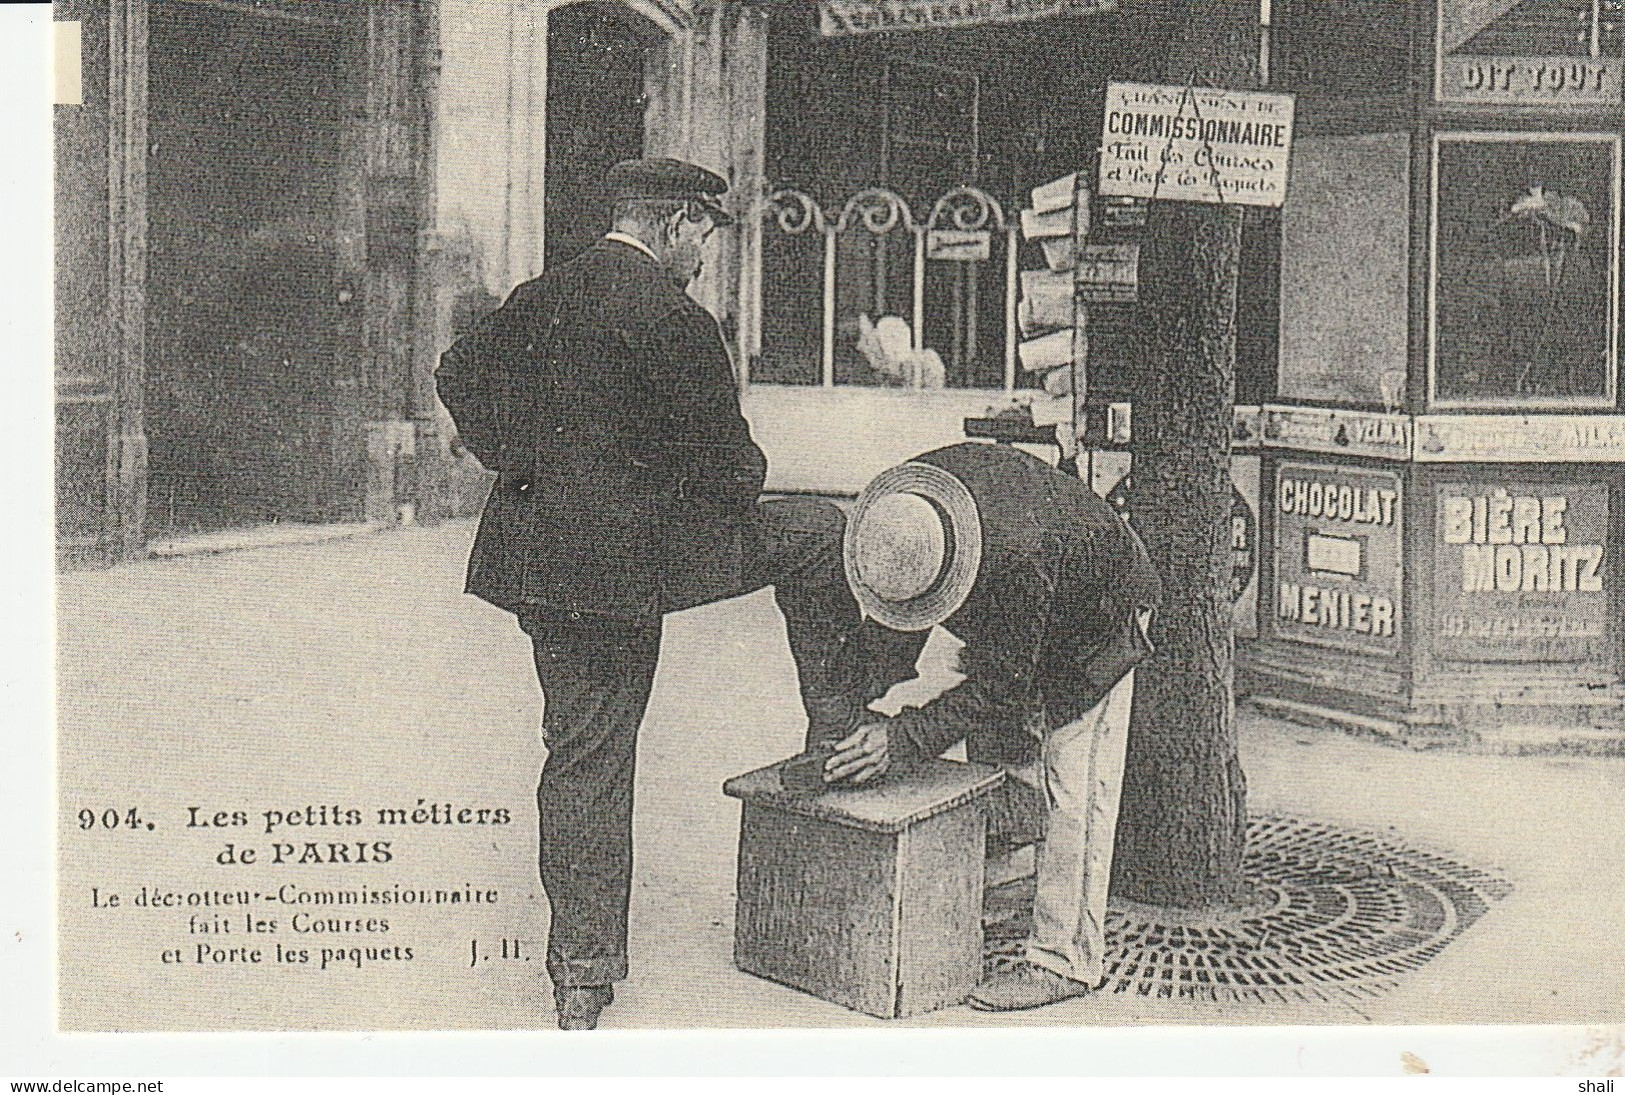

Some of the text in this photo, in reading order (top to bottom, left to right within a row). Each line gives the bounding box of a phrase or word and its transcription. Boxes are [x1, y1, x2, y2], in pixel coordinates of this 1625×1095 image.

[1108, 111, 1286, 147] COMMISSIONNAIRE
[1280, 479, 1397, 525] CHOCOLAT
[1443, 488, 1567, 545] BIÈRE
[1460, 544, 1604, 593] MORITZ
[1278, 583, 1396, 638] MENIER
[186, 806, 249, 829] Les
[263, 805, 363, 833] petits
[377, 798, 512, 826] métiers
[216, 841, 394, 866] de PARIS
[92, 888, 121, 909] Le
[189, 912, 391, 936] fait les Courses
[161, 945, 183, 964] et
[197, 944, 262, 964] Porte
[276, 944, 308, 964] les
[320, 945, 414, 970] paquets
[470, 939, 491, 967] J.
